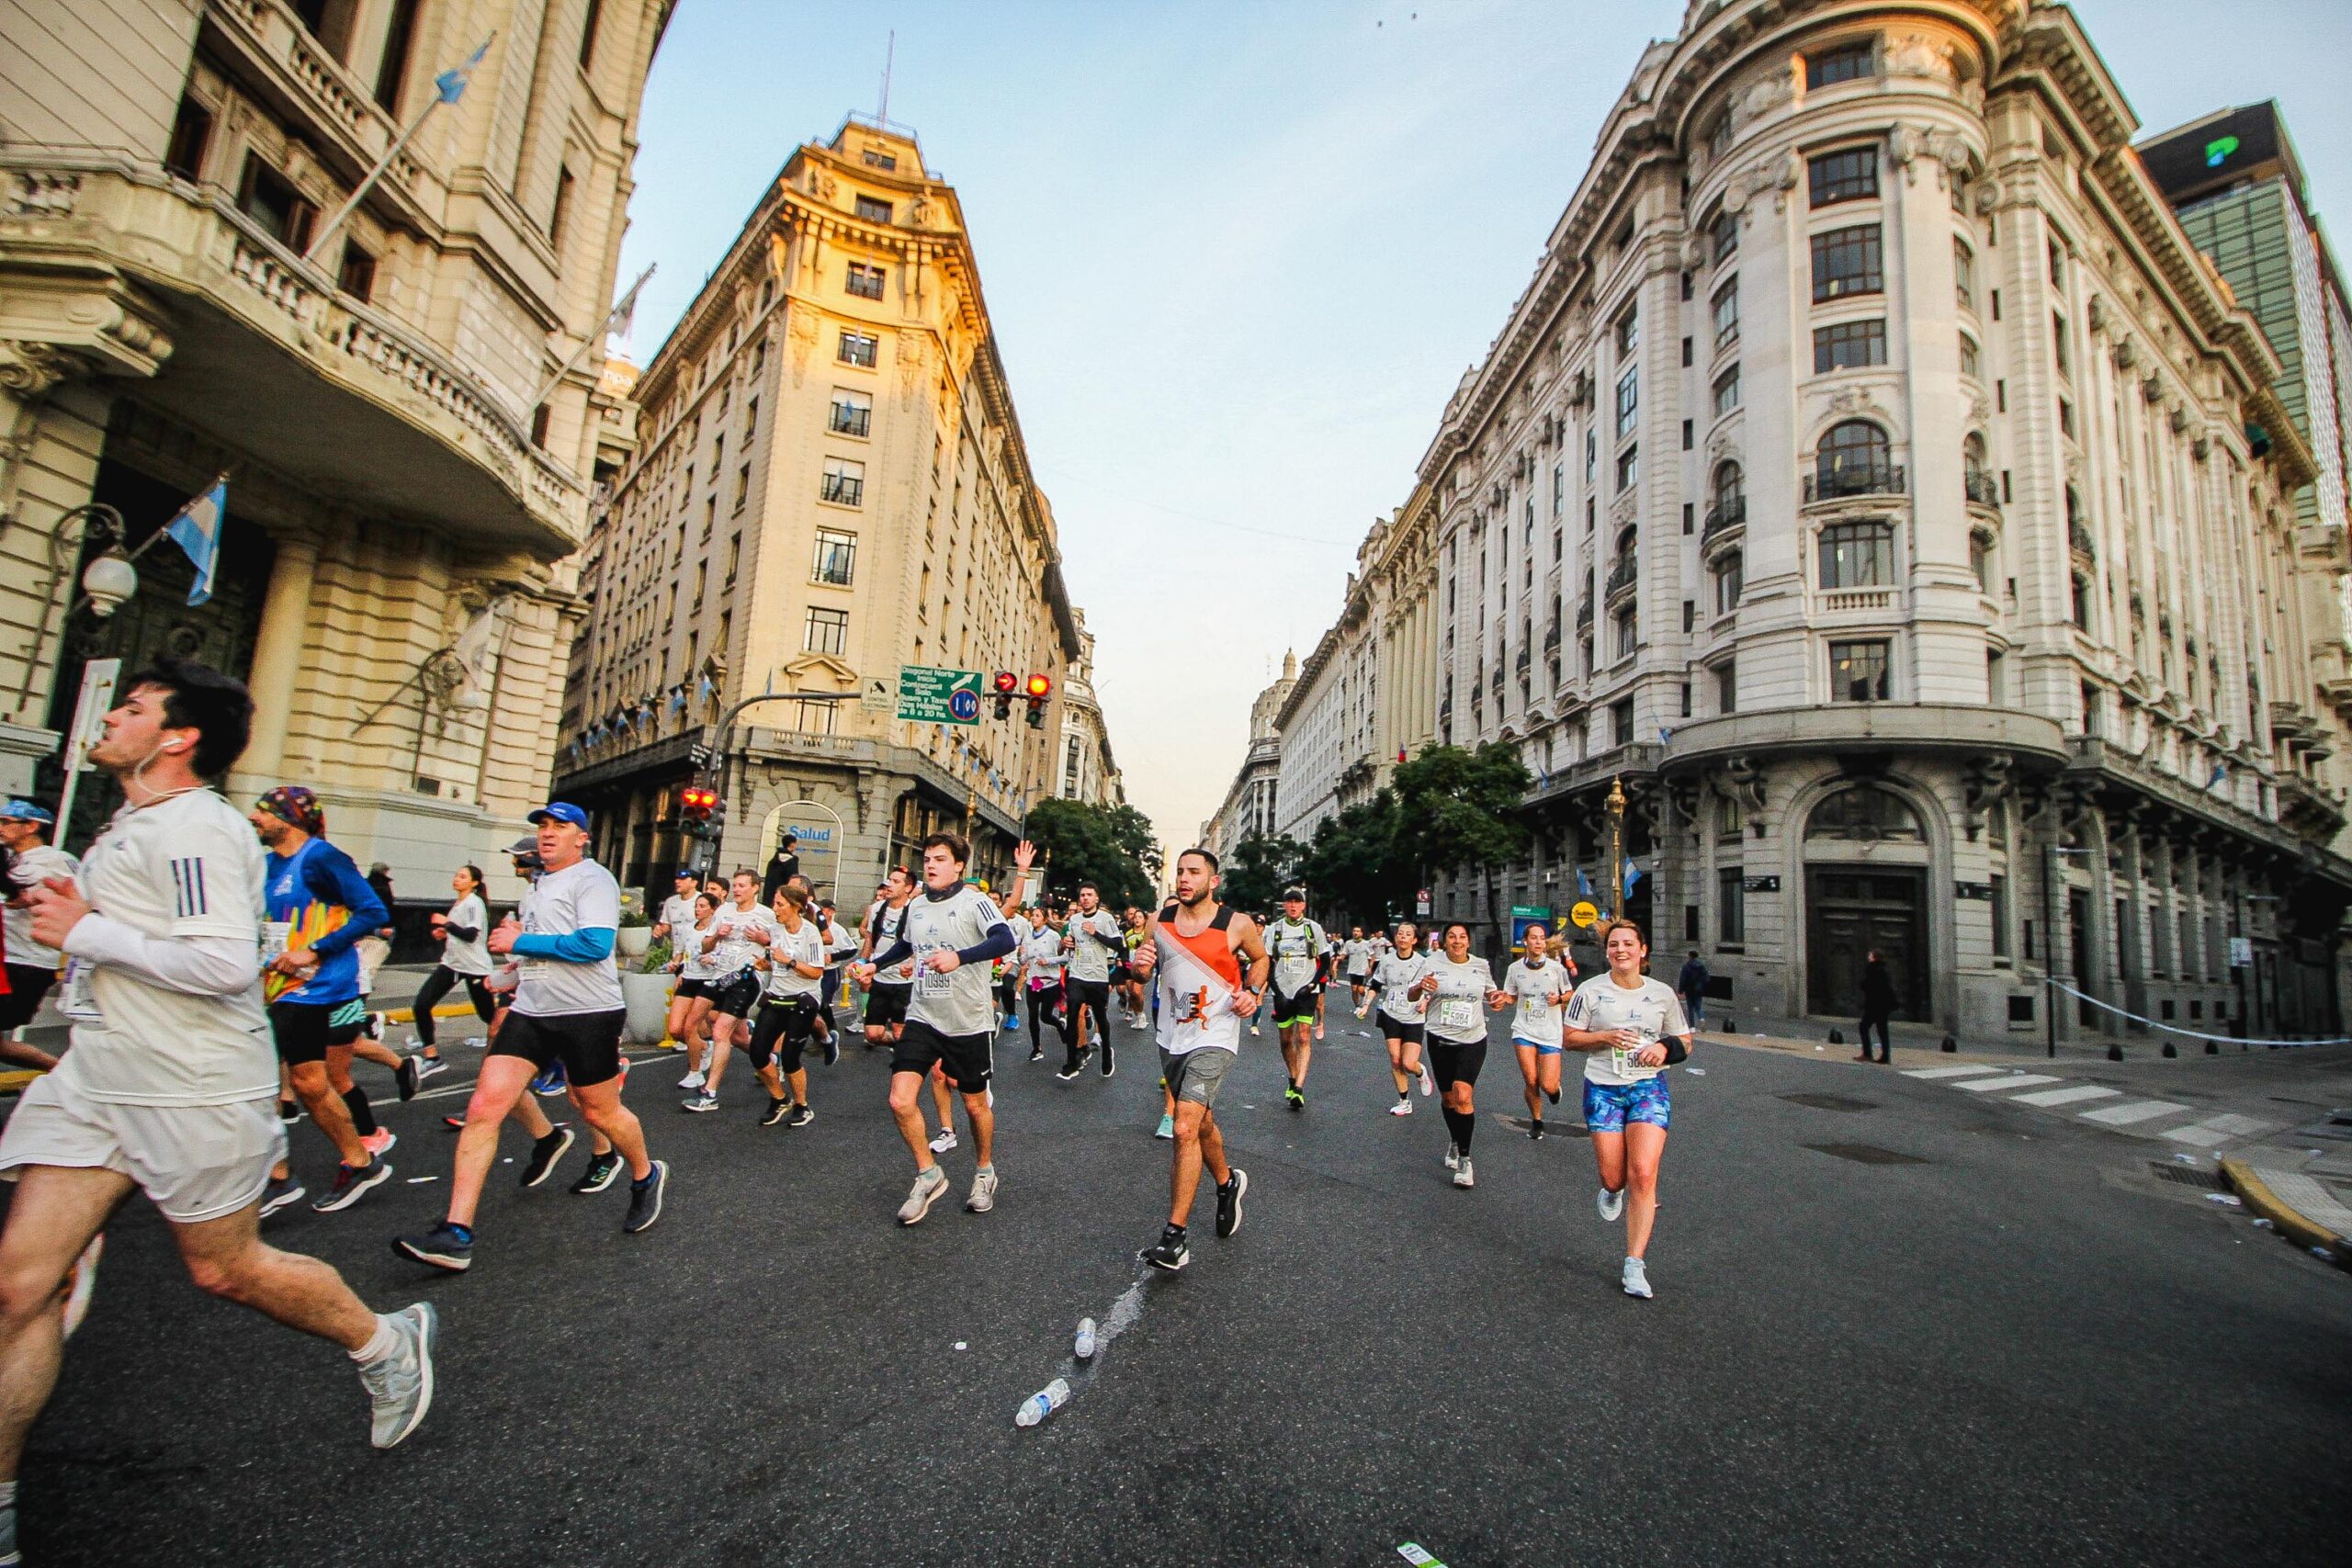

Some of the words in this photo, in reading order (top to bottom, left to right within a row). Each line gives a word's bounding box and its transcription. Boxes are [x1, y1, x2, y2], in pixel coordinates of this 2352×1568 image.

[933, 670, 956, 678] Norte
[789, 825, 831, 841] Salud
[924, 973, 951, 988] 10999
